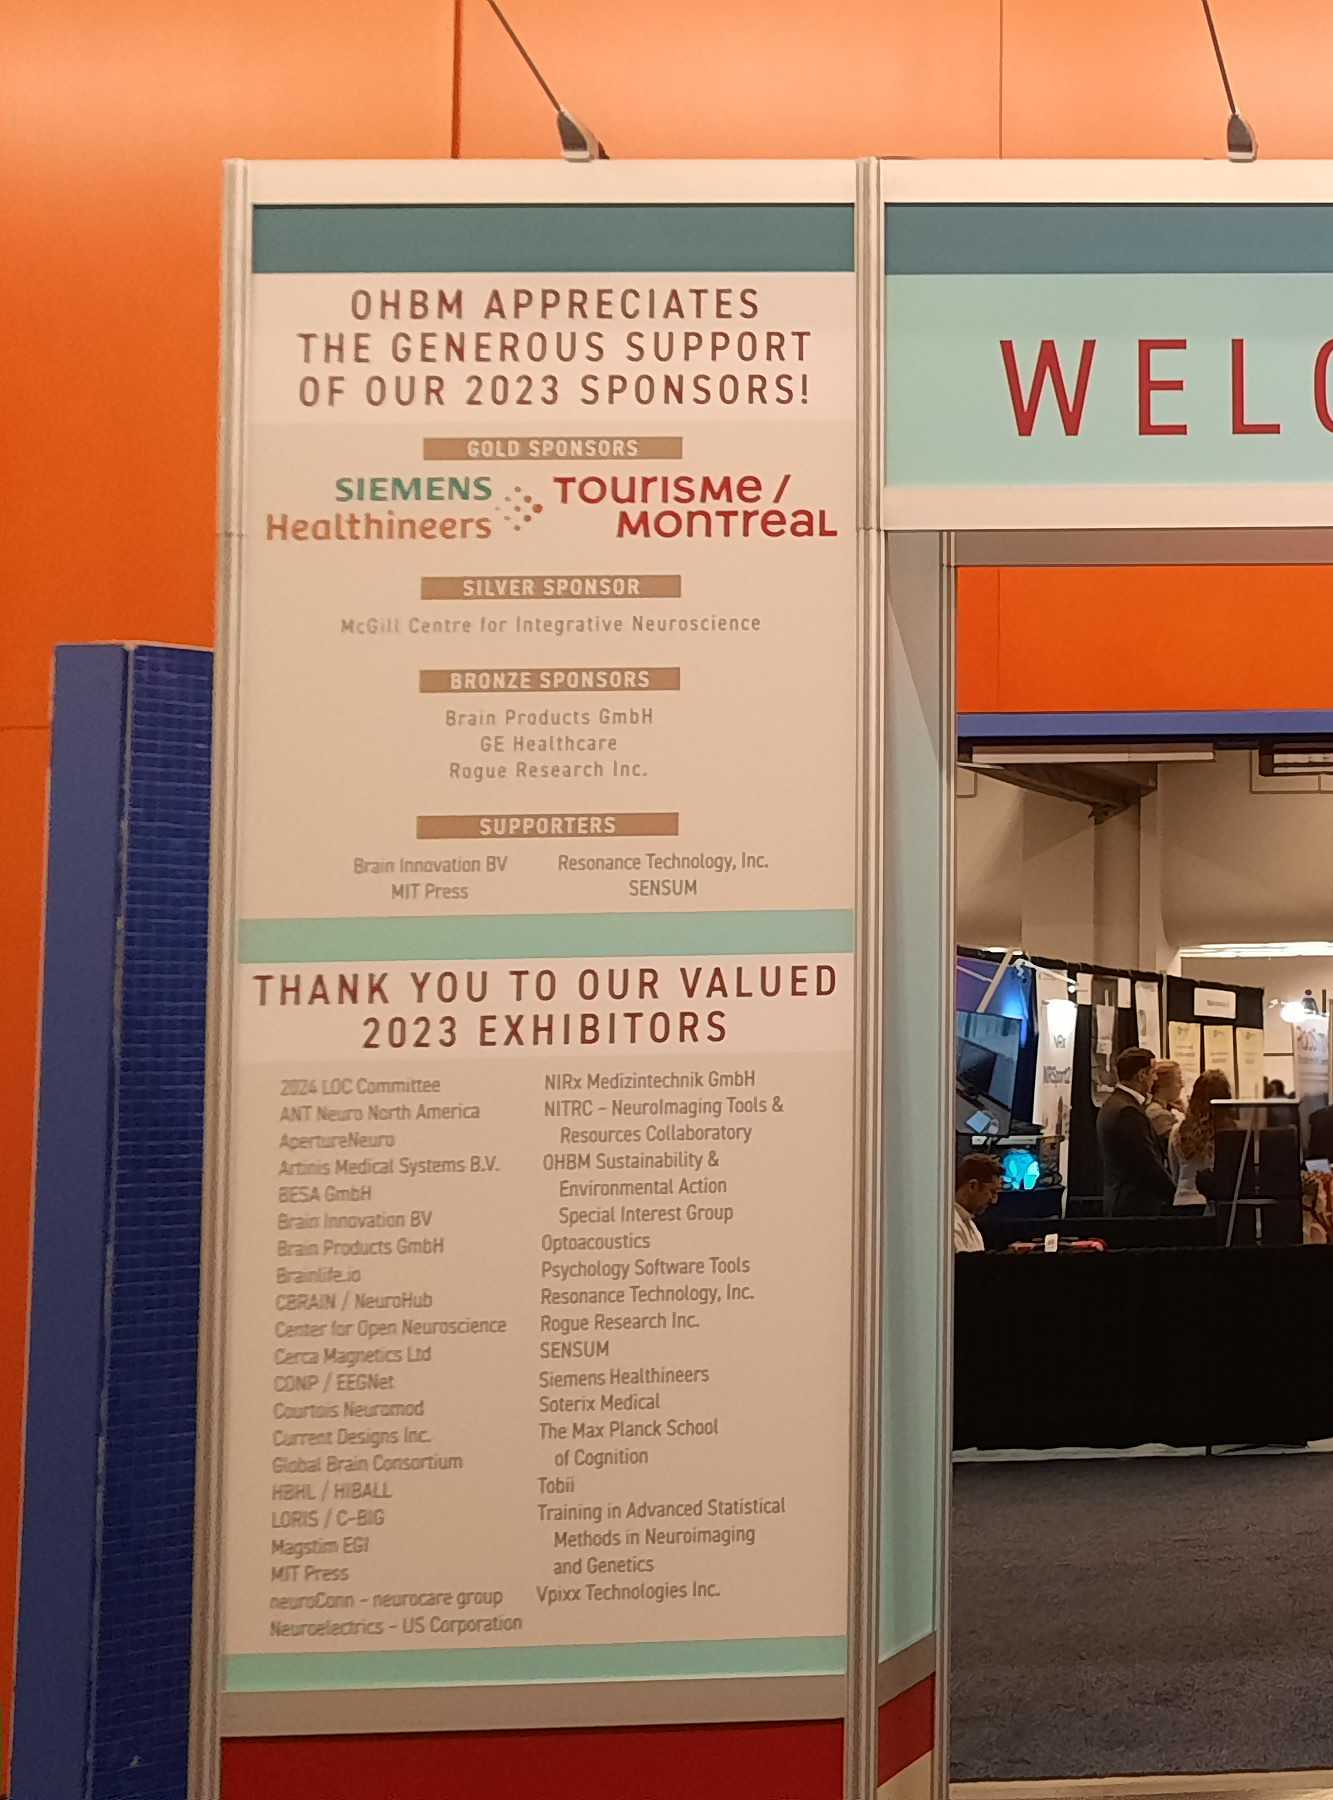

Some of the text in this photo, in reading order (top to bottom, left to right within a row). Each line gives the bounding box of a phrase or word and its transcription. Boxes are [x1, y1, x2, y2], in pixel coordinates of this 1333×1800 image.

[352, 288, 758, 320] OHBM APPRECIATES
[298, 331, 811, 363] THE GENEROUS SUPPORT
[300, 374, 809, 406] OF OUR 2023 SPONSORS!
[466, 438, 641, 459] GOLD SPONSORS
[336, 477, 492, 502] SIEMENS
[267, 510, 491, 541] Healthineers
[463, 577, 641, 597] SILVER SPONSOR
[339, 613, 761, 637] McGill Centre for Integrative Neuroscience
[450, 669, 651, 691] BRONZE SPONSORS
[445, 706, 653, 727] Brain Products GmbH
[480, 734, 617, 753] GE Healthcare
[449, 758, 649, 784] Rogue Research Inc.
[479, 816, 617, 836] SUPPORTERS
[353, 855, 509, 876] Brain Innovation BV
[557, 851, 769, 873] Resonance Technology, Inc.
[391, 881, 469, 901] MIT Press
[628, 878, 698, 897] SENSUM
[253, 965, 835, 1005] THANK YOU TO OUR VALUED
[363, 1011, 726, 1049] 2023 EXHIBITORS
[355, 1076, 441, 1095] Committee
[544, 1069, 756, 1091] NIRx Medizintechnik GmbH
[316, 1105, 364, 1123] Neuro
[367, 1103, 412, 1121] North
[415, 1102, 481, 1121] America
[544, 1098, 593, 1118] NITRC
[725, 1095, 768, 1114] Tools
[560, 1123, 753, 1145] Resources Collaboratory
[334, 1155, 501, 1178] Medical Systems B.V.
[542, 1149, 704, 1172] OHBM Sustainability
[559, 1175, 727, 1198] Environmental Action
[558, 1203, 734, 1229] Special Interest Group
[541, 1231, 651, 1256] Optoacoustics
[541, 1255, 751, 1283] Psychology Software Tools
[540, 1282, 755, 1306] Resonance Technology, Inc.
[274, 1316, 508, 1341] Center for Open Neuroscience
[540, 1311, 700, 1337] Rogue Research Inc.
[323, 1346, 404, 1369] Magnetics
[406, 1345, 432, 1363] Ltd
[539, 1339, 610, 1360] SENSUM
[538, 1365, 710, 1389] Siemens Healthineers
[539, 1391, 661, 1413] Soterix Medical
[272, 1426, 433, 1449] Current Designs Inc.
[537, 1417, 719, 1441] The Max Planck School
[271, 1453, 464, 1475] Global Brain Consortium
[554, 1447, 649, 1471] of Cognition
[536, 1476, 575, 1495] Tobii
[536, 1496, 786, 1524] Training in Advanced Statistical
[553, 1524, 756, 1549] Methods in Neuroimaging
[271, 1564, 350, 1583] MIT Press
[552, 1555, 655, 1576] and Genetics
[372, 1591, 454, 1608] neurocare
[455, 1590, 504, 1611] group
[535, 1580, 721, 1607] Vpixx Technologies Inc.
[402, 1615, 426, 1634] US
[429, 1613, 524, 1637] Corporation
